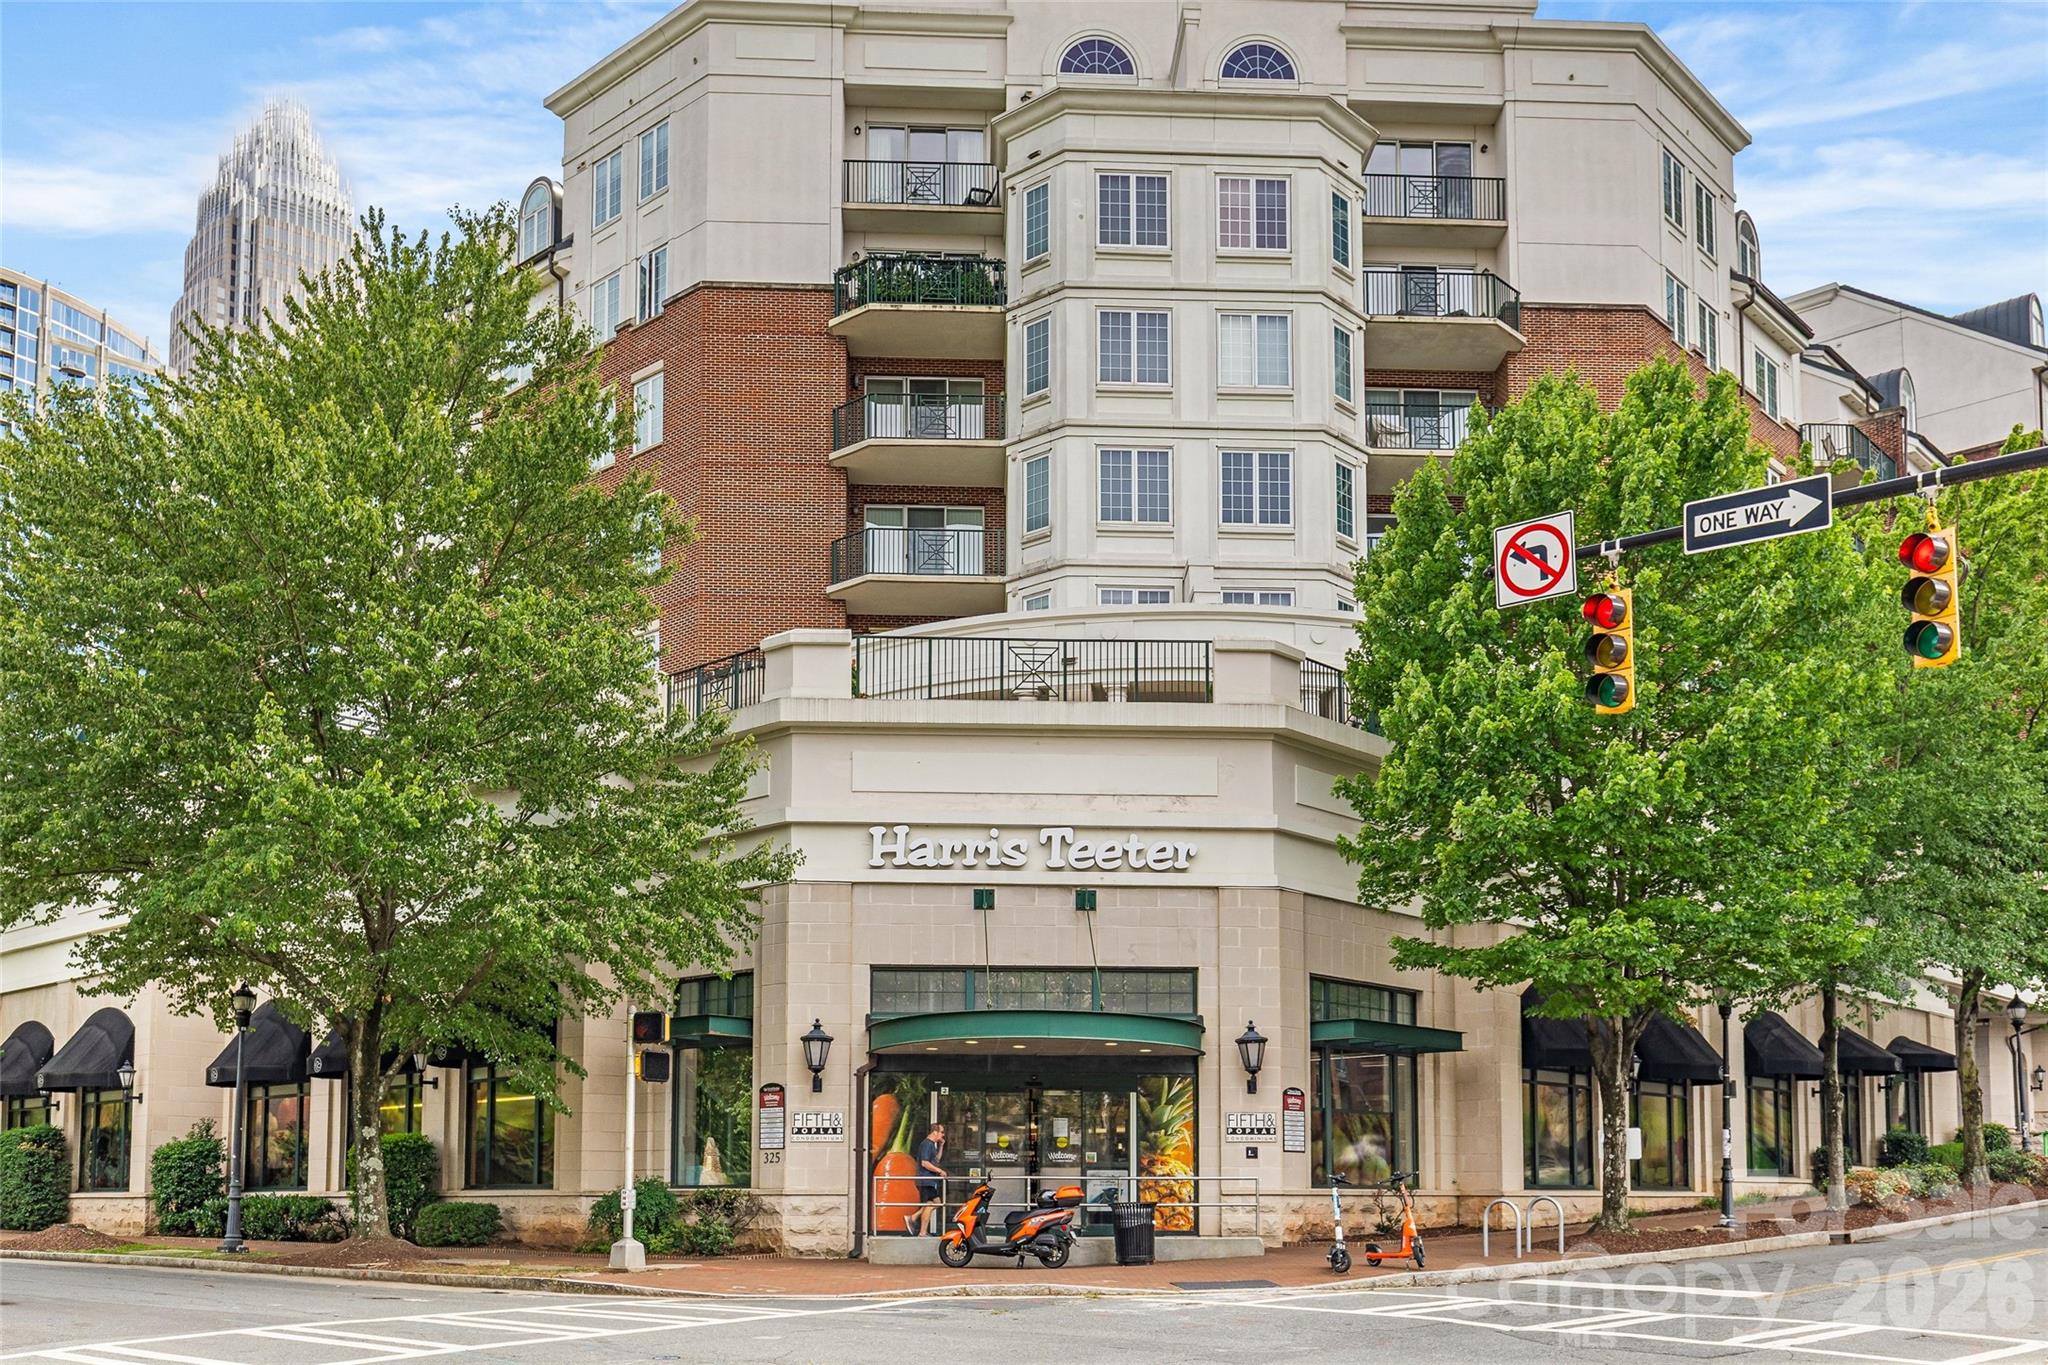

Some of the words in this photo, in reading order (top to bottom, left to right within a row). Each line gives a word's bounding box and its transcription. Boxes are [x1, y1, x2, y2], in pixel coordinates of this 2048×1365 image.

[1700, 511, 1737, 533] ONE
[1745, 501, 1784, 524] WAY
[868, 824, 1029, 868] Harris
[1039, 826, 1198, 871] Teeter
[763, 1152, 781, 1164] 325
[989, 1151, 1018, 1160] Welcome
[1048, 1151, 1077, 1161] Welcome
